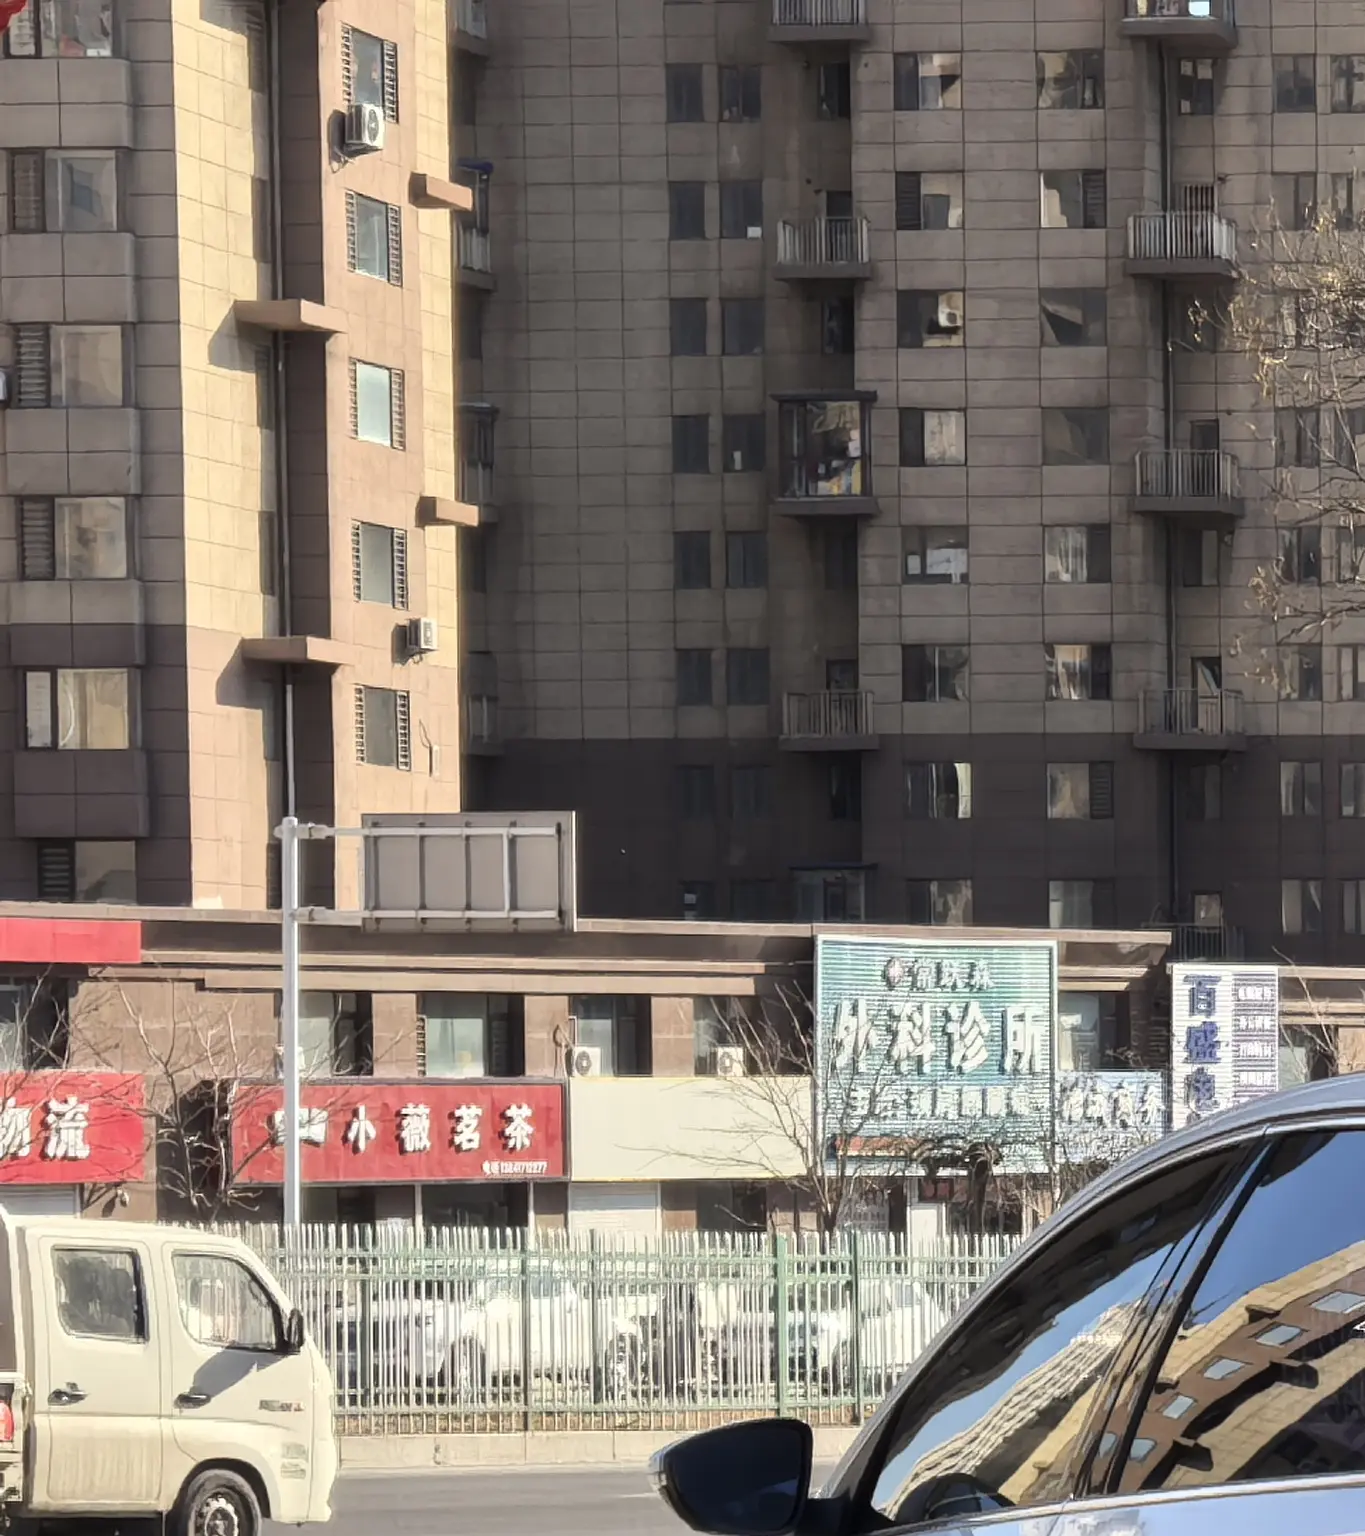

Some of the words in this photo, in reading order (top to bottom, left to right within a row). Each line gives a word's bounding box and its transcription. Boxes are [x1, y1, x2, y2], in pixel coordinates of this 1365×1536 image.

[834, 998, 1048, 1077] 外科诊所
[348, 1103, 534, 1153] 小薇茗茶
